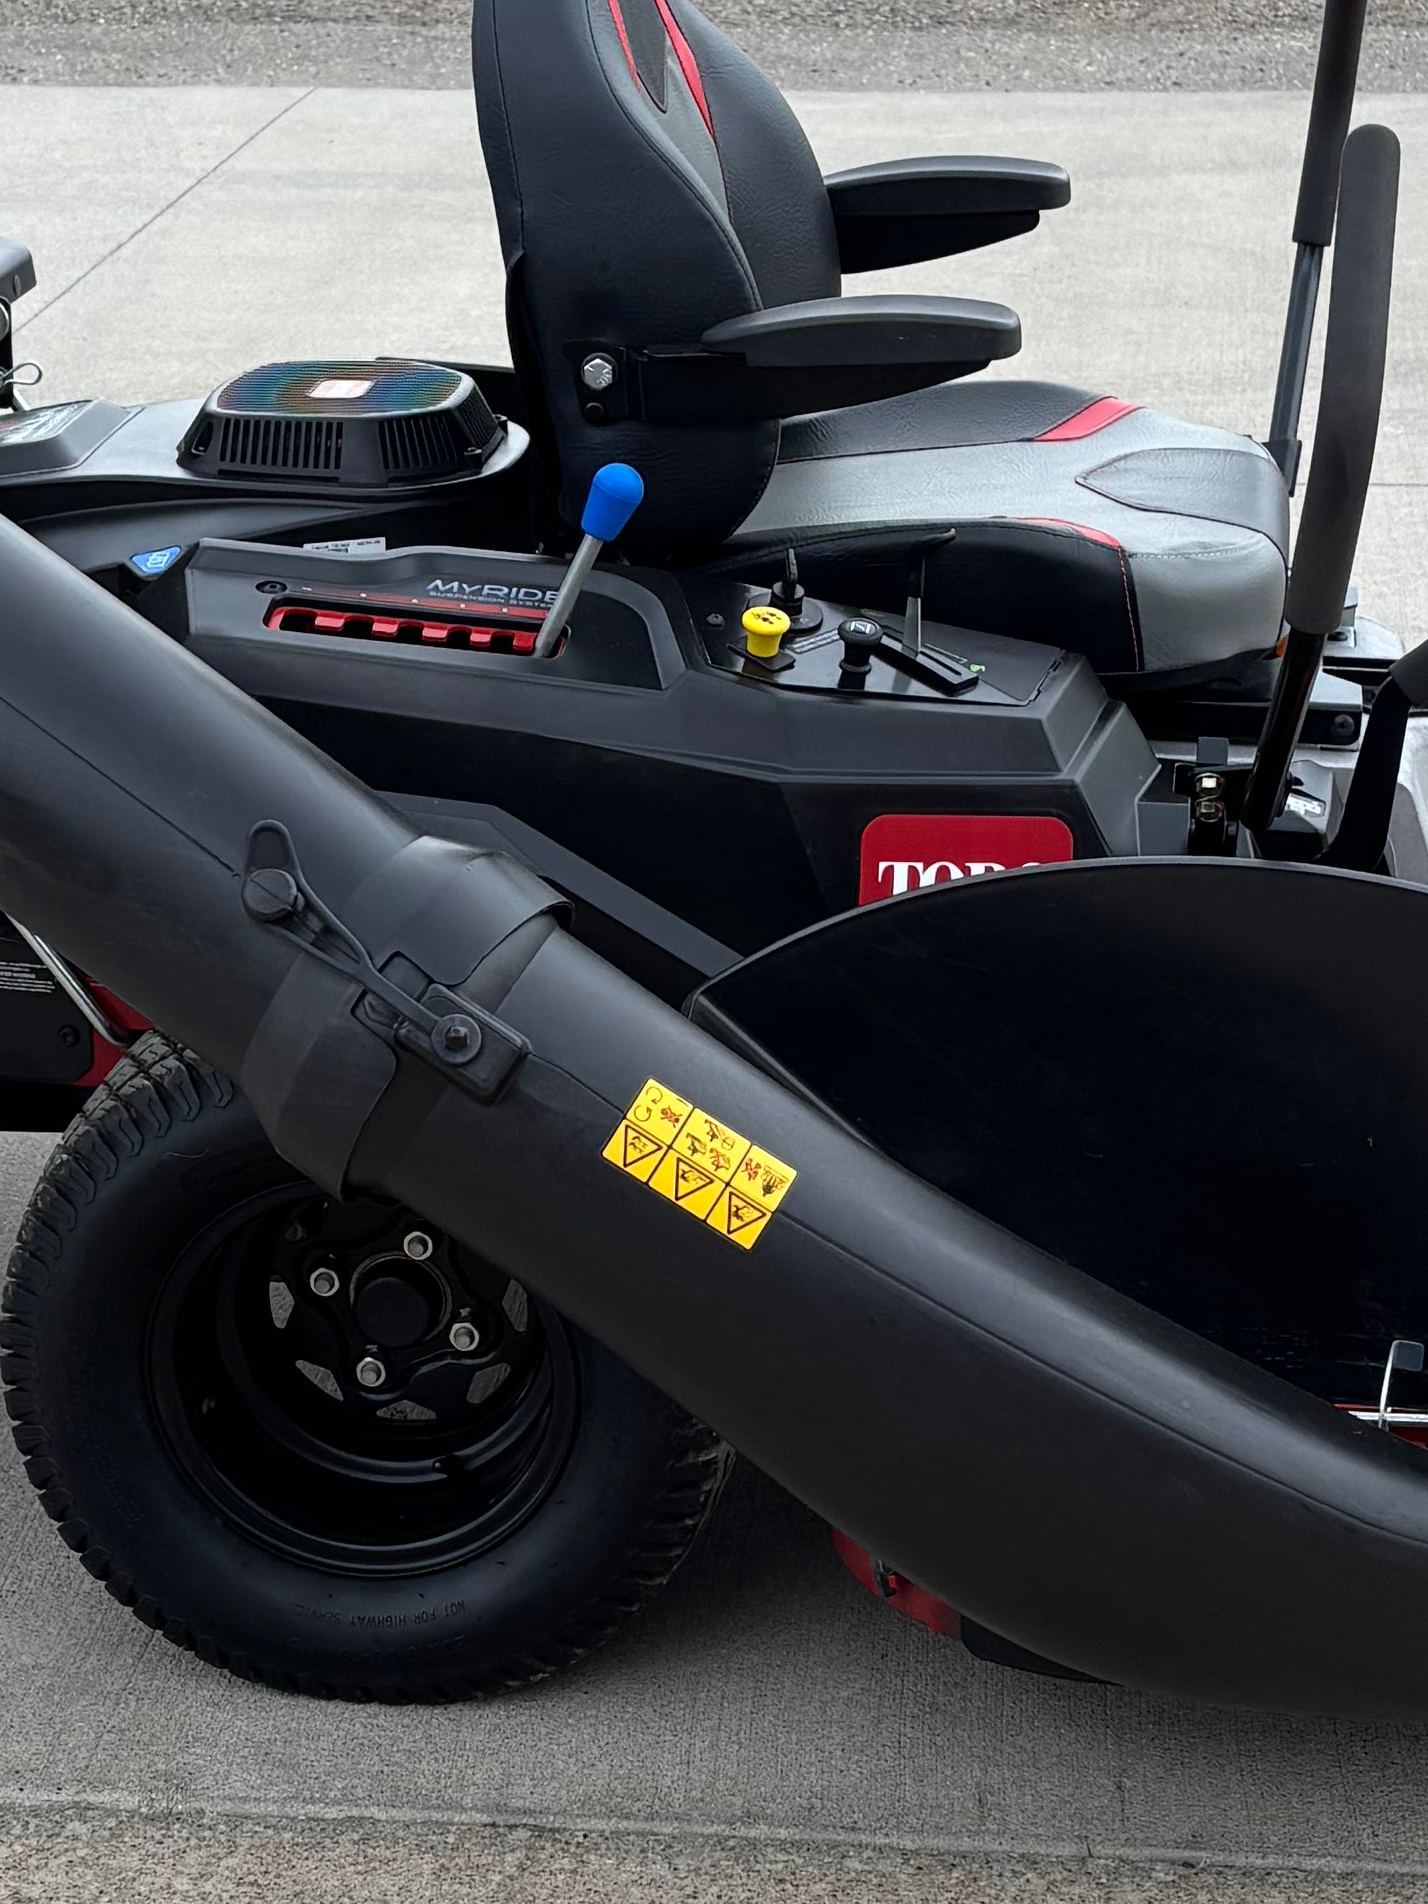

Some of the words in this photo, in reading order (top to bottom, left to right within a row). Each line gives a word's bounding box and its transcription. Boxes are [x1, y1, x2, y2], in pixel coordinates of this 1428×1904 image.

[429, 590, 505, 604] SUSPENSION
[878, 861, 1041, 896] TO
[351, 1614, 408, 1628] HIGHWAY
[413, 1610, 437, 1625] FOR
